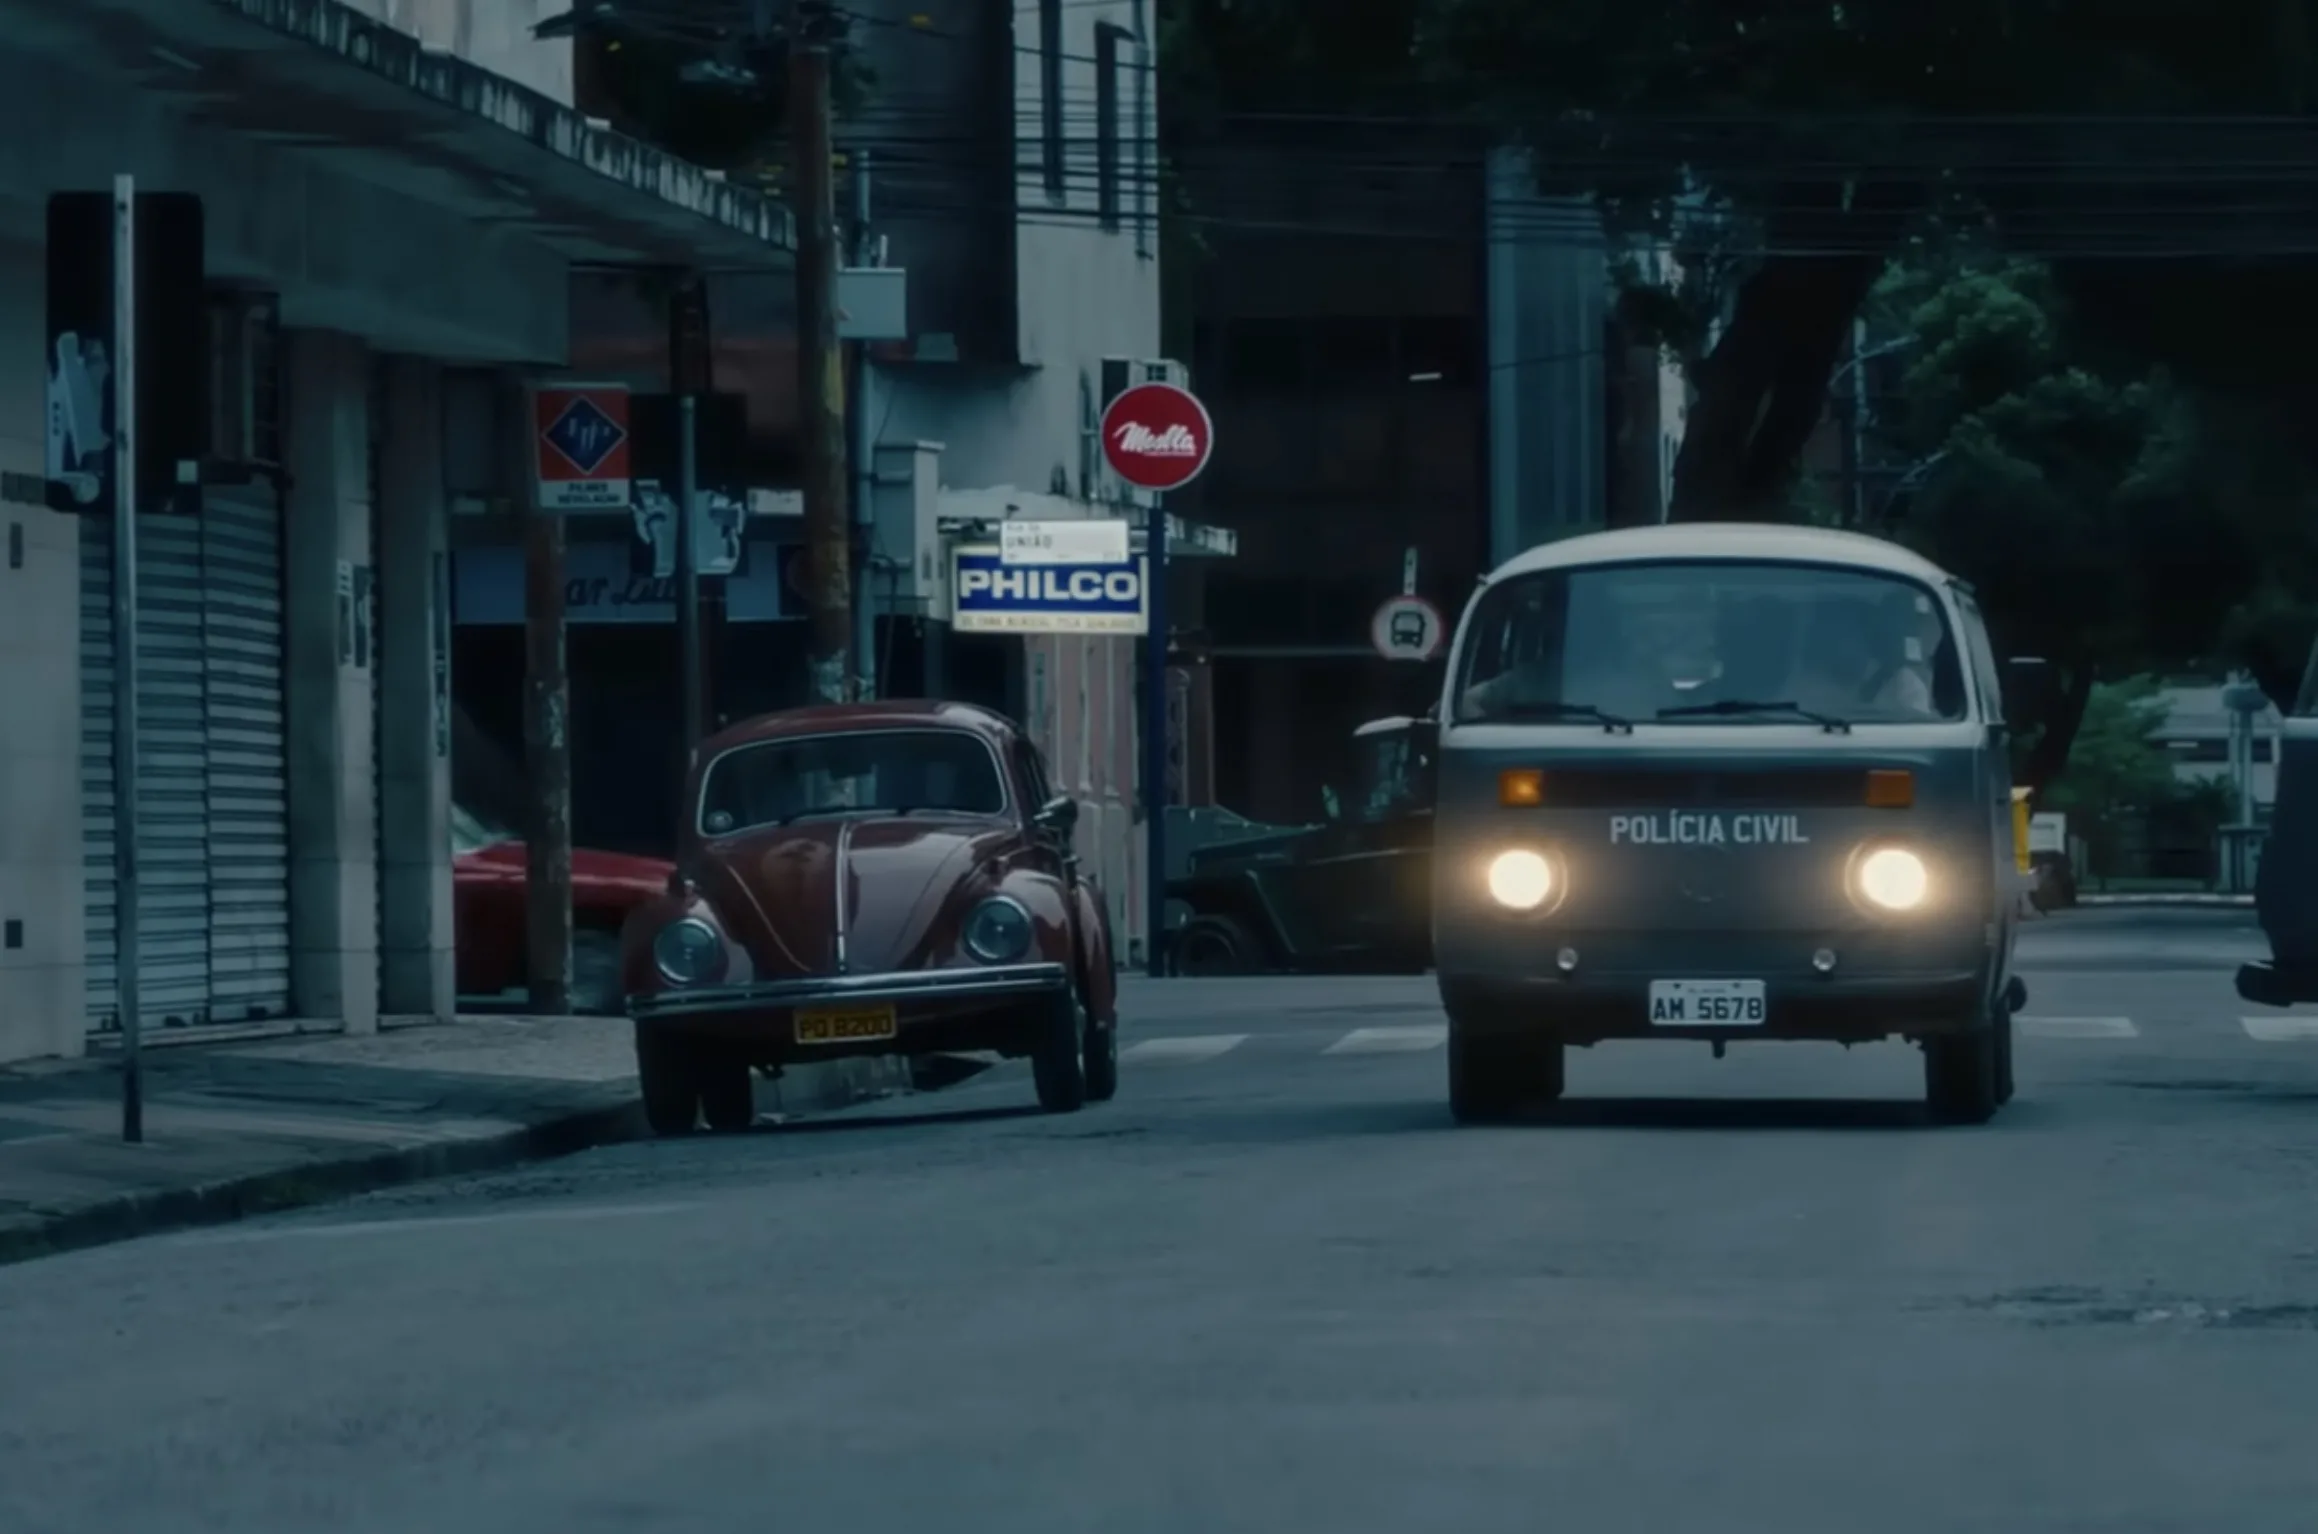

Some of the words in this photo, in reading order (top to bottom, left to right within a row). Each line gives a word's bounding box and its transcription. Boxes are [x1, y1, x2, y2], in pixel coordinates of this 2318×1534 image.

[959, 568, 1139, 600] PHILCO
[1610, 808, 1725, 844] POLÍCIA
[1733, 814, 1811, 844] CIVIL
[1654, 997, 1685, 1020] AM
[1697, 996, 1762, 1020] 5678
